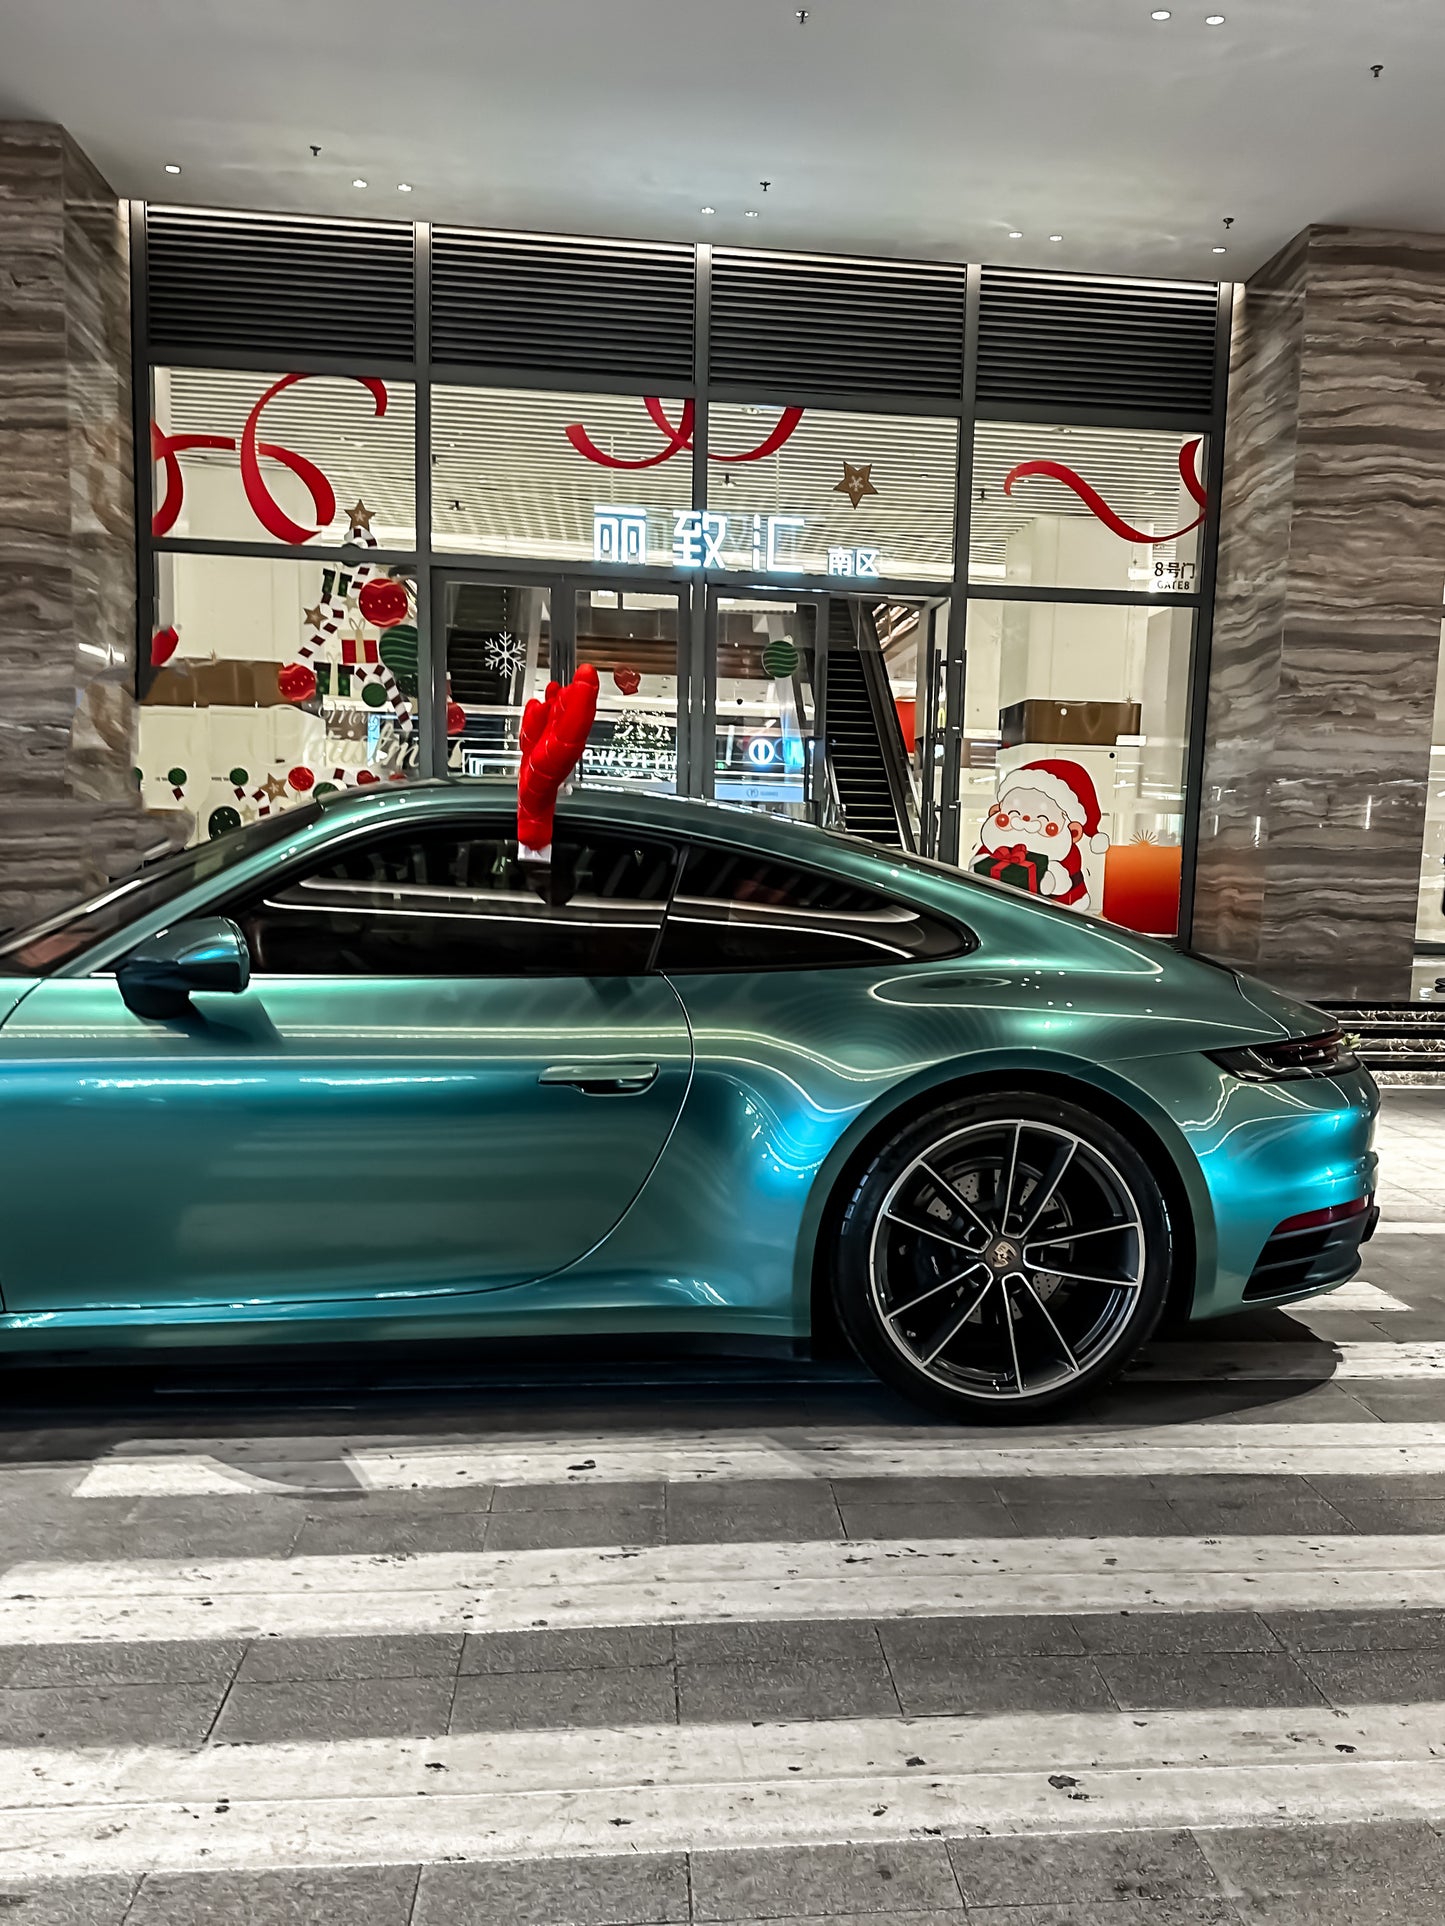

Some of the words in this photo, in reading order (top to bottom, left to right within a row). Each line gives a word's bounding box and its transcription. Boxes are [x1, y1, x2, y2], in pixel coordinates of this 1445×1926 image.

[593, 505, 805, 573] 丽致汇
[828, 547, 880, 577] 南区
[1154, 562, 1196, 579] 8号门
